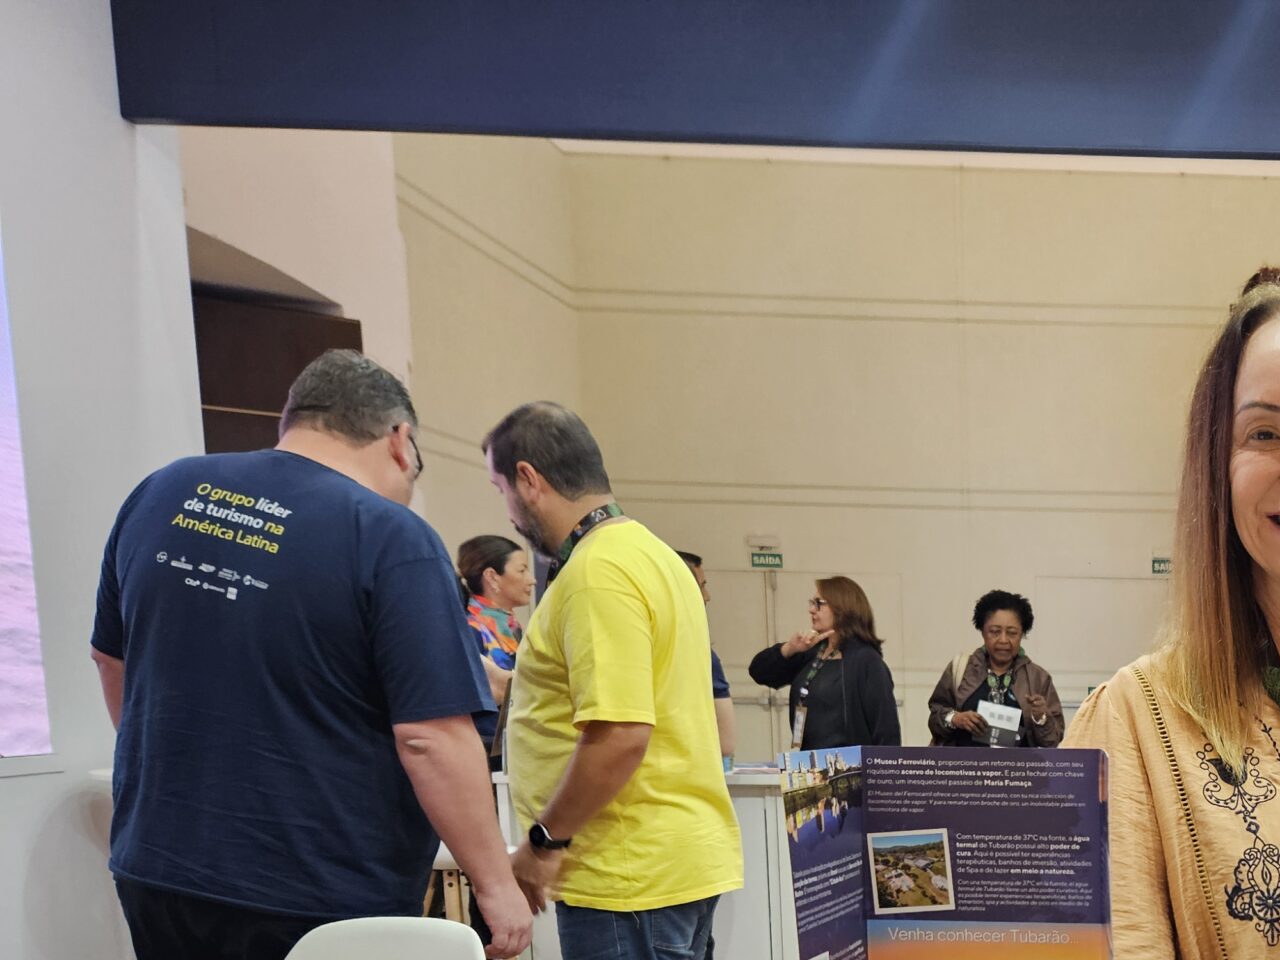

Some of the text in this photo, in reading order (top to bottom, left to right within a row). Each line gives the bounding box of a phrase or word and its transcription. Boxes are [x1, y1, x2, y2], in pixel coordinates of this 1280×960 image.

[197, 483, 293, 519] O grupo líder
[184, 498, 285, 536] de turismo na
[172, 513, 279, 554] América Latina
[753, 555, 782, 565] SAÍDA
[938, 759, 978, 767] proporciona
[1010, 770, 1026, 778] para
[1026, 769, 1048, 777] fechar
[1064, 770, 1085, 778] chave
[984, 779, 1004, 787] Maria
[1073, 835, 1090, 843] água
[1050, 843, 1071, 851] poder
[966, 866, 979, 874] Spa
[888, 927, 934, 942] Venha
[937, 928, 1006, 943] conhecer
